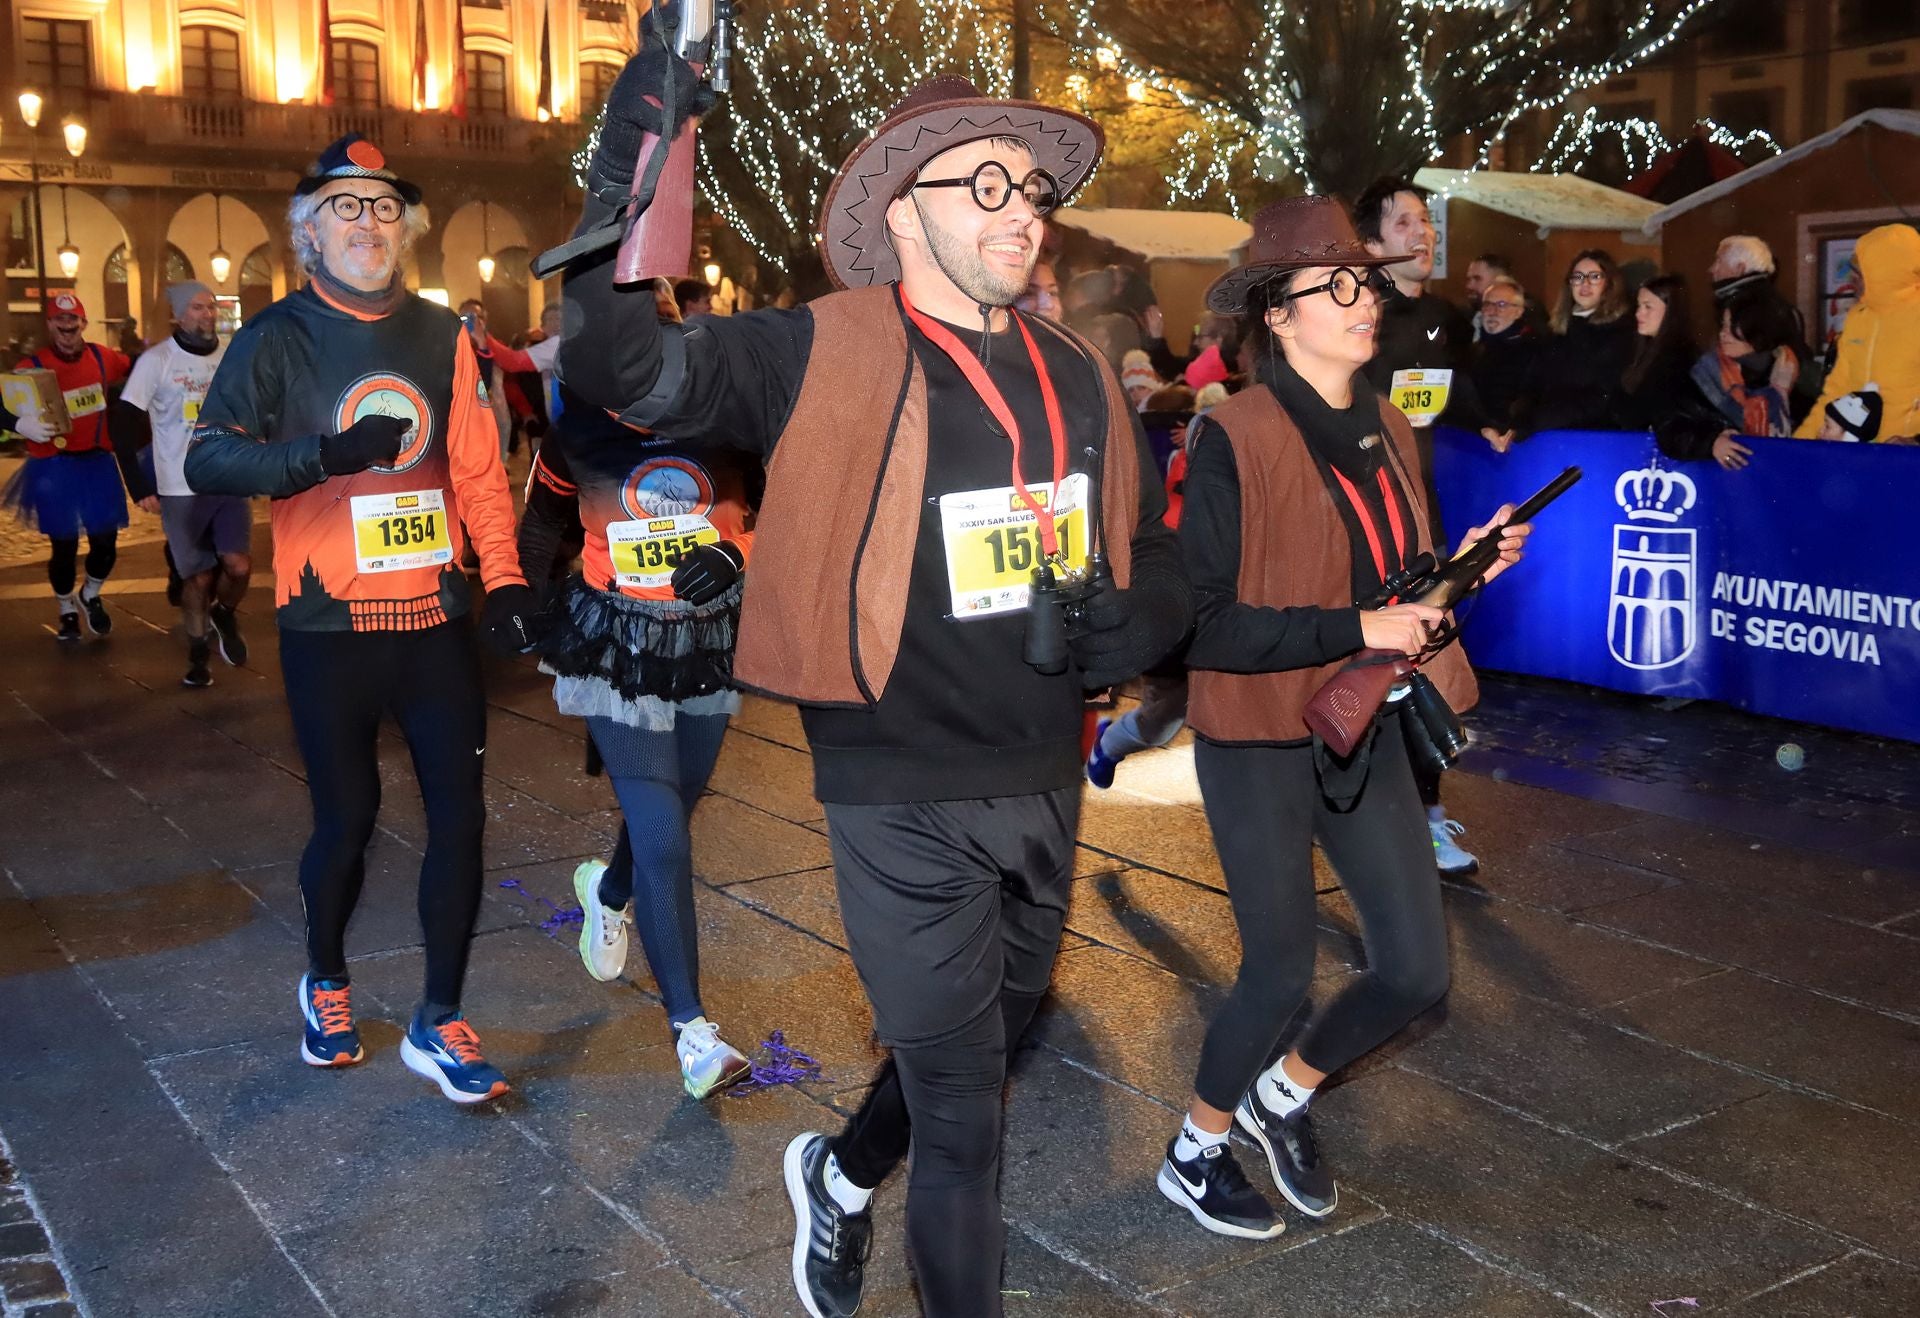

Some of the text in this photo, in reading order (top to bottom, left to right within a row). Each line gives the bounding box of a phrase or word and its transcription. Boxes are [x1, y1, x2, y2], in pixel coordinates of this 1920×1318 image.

[75, 393, 97, 408] 1470
[1402, 390, 1432, 409] 3313
[395, 508, 420, 516] SILVESTRE
[959, 518, 985, 529] XXXIV
[988, 517, 1005, 526] SAN
[1007, 511, 1051, 523] SILVES
[378, 514, 435, 547] 1354
[648, 531, 677, 539] SILVESTRE
[678, 525, 710, 535] SEGOVIANA
[1711, 608, 1881, 666] DE SEGOVIA
[1206, 1147, 1219, 1157] NIKE
